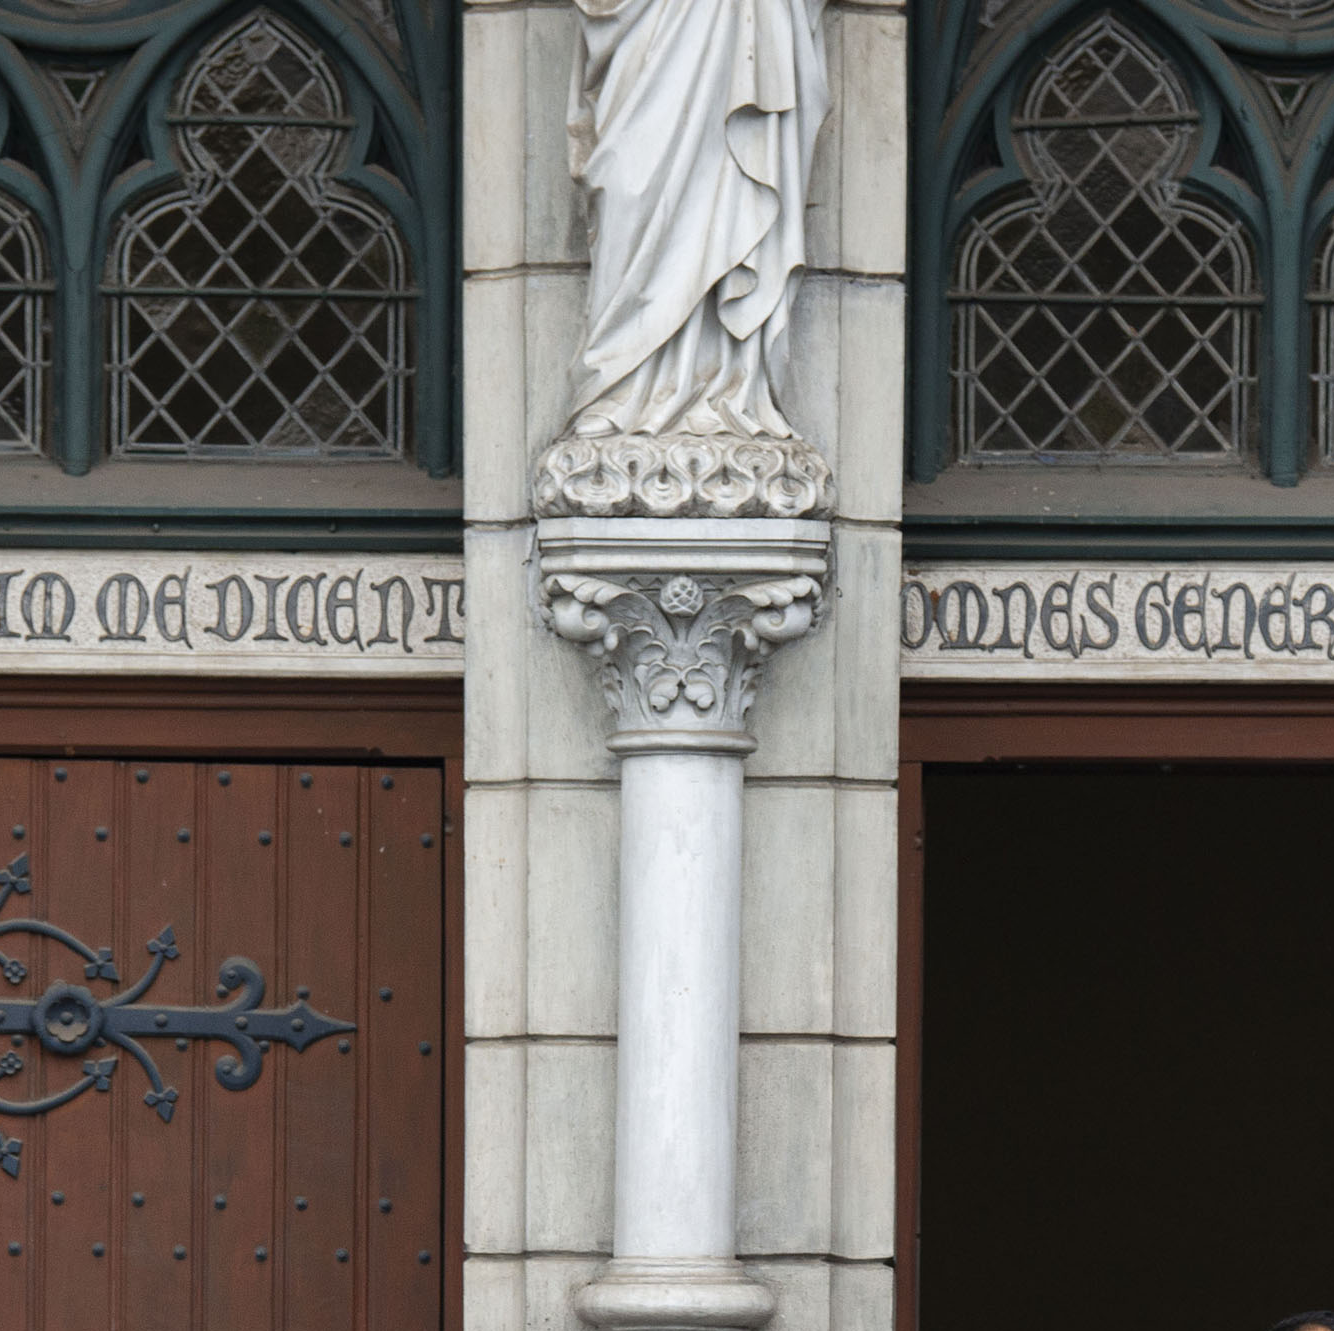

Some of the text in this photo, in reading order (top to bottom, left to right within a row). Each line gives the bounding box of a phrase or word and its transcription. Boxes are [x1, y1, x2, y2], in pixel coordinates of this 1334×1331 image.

[96, 564, 193, 650] ME
[204, 567, 465, 653] DICENT
[900, 570, 1120, 659] OMNES
